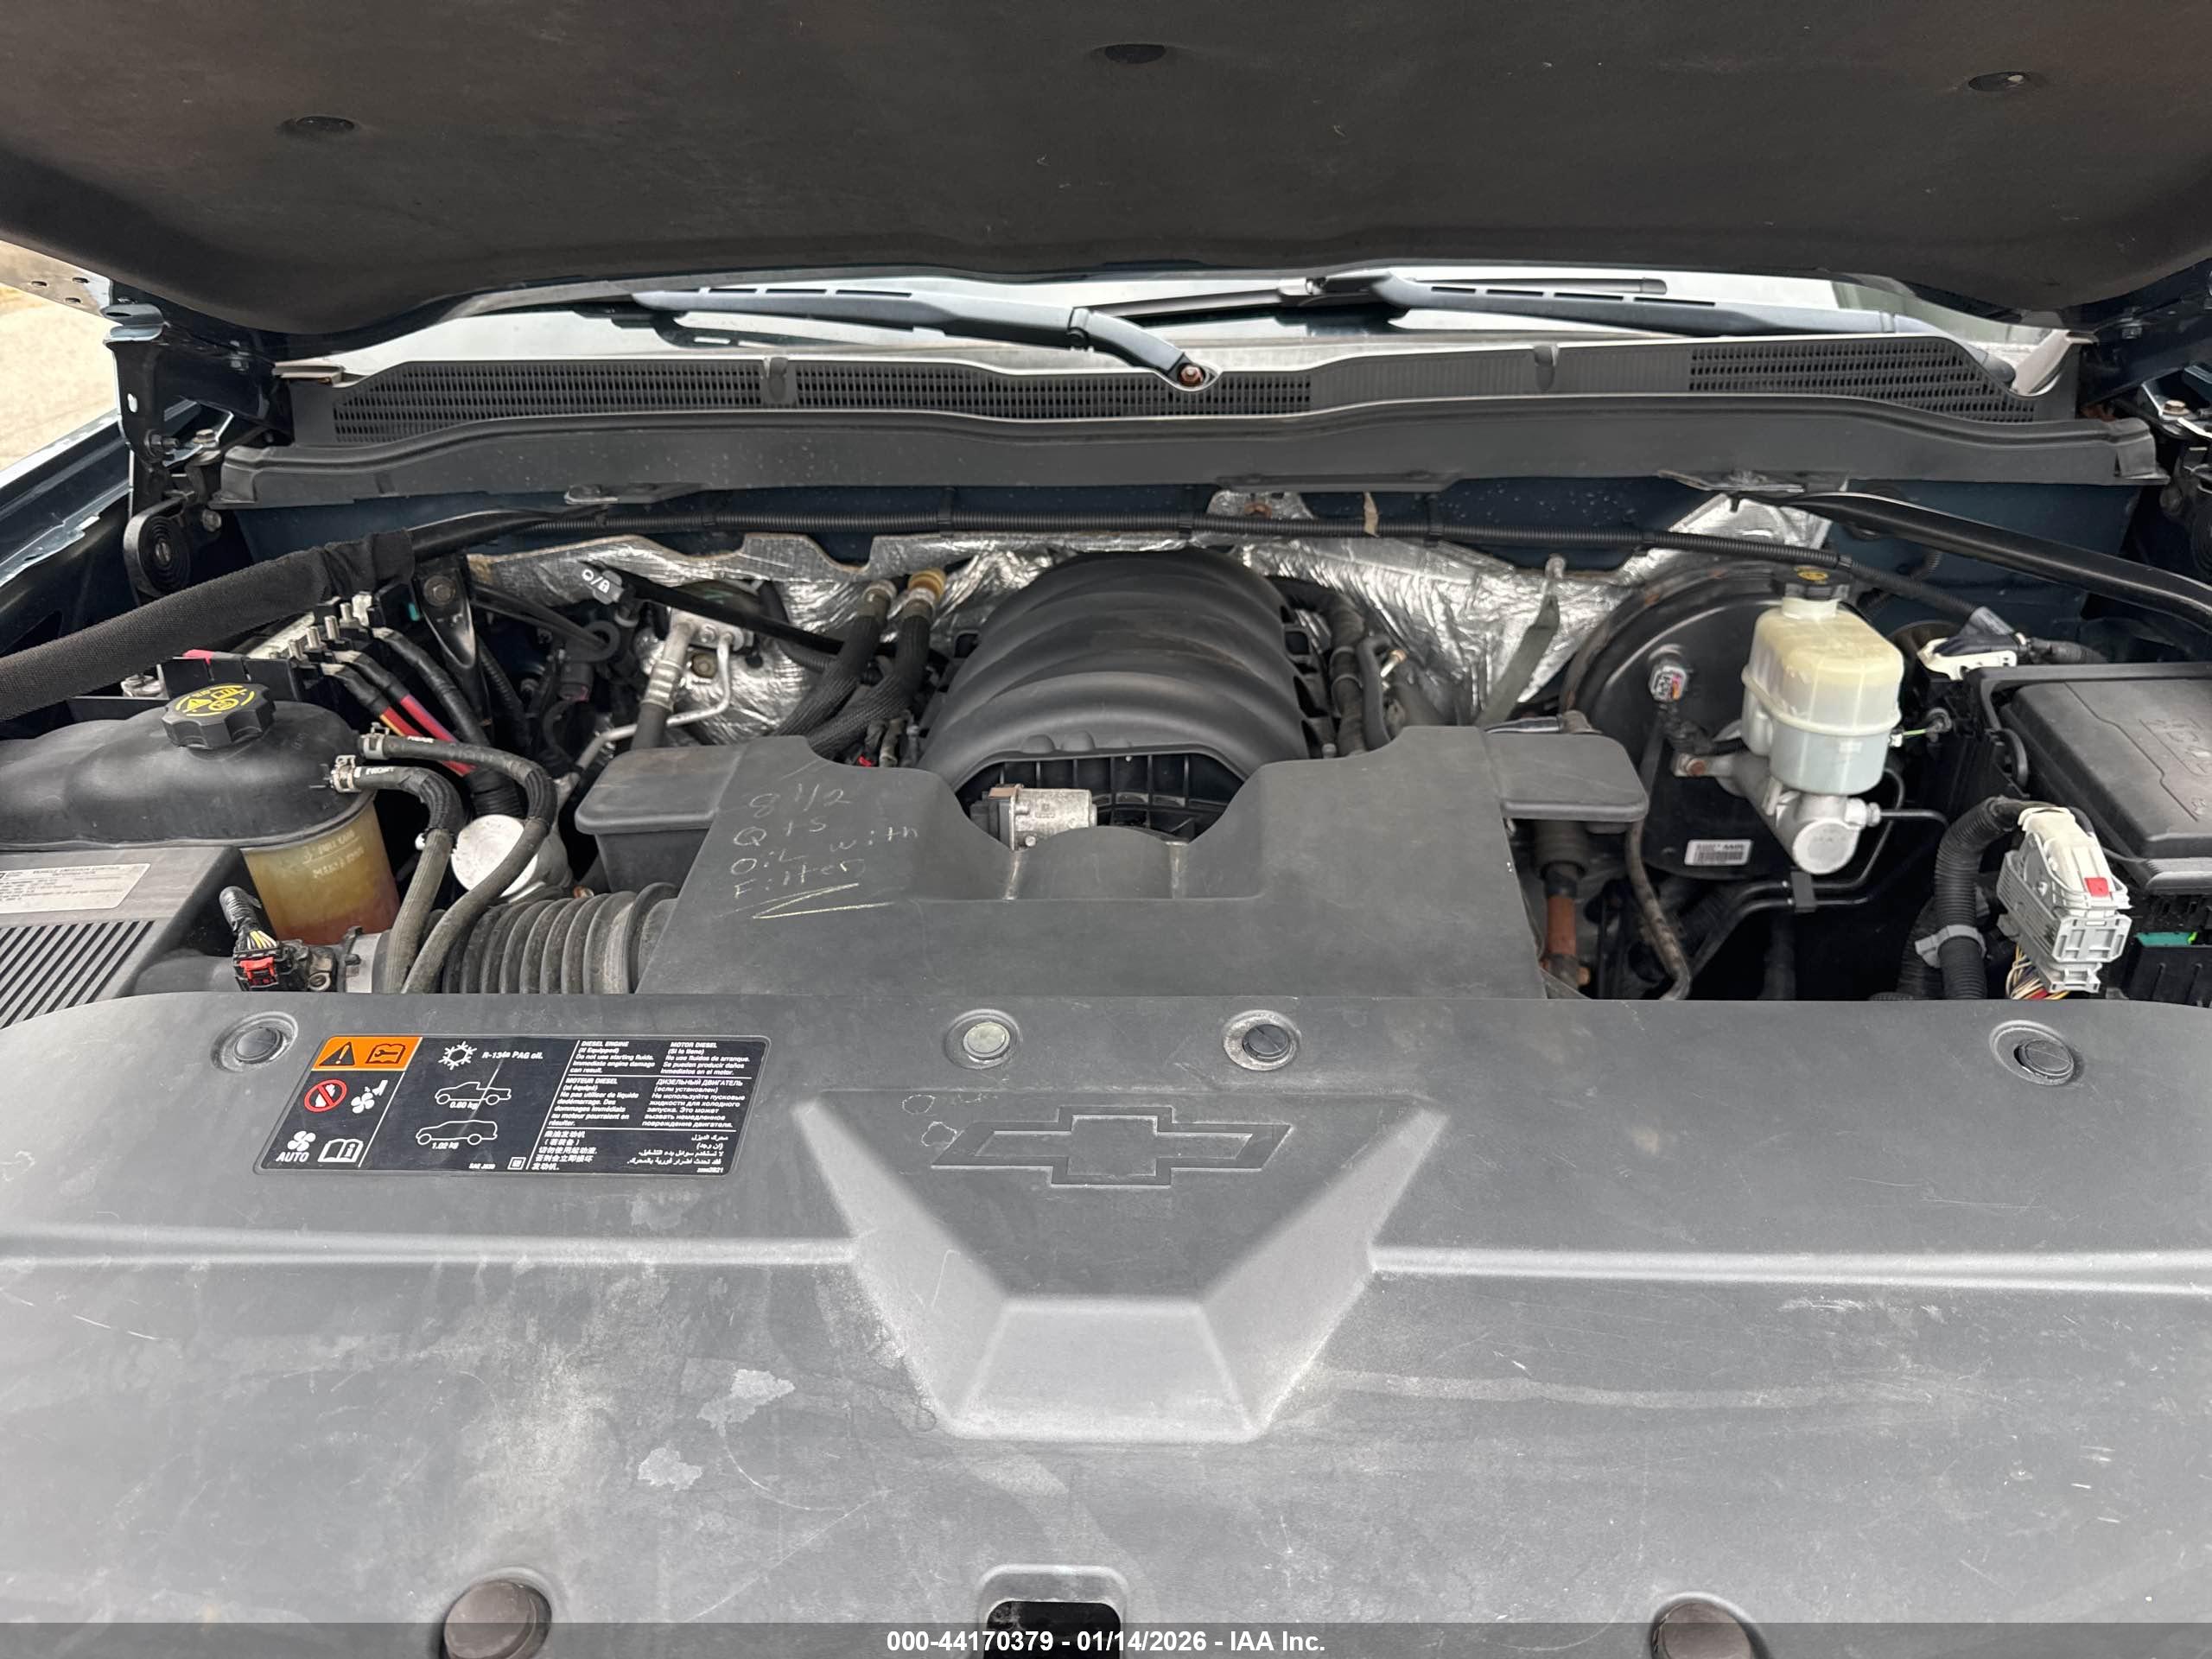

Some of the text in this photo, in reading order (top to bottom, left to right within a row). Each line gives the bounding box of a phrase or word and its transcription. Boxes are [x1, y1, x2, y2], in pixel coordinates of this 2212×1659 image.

[749, 792, 780, 818] 8
[830, 824, 918, 852] with
[512, 1051, 531, 1059] PAG
[656, 1077, 702, 1086] ДИЗЕЛЬНЫЙ
[275, 1151, 310, 1162] AUTO
